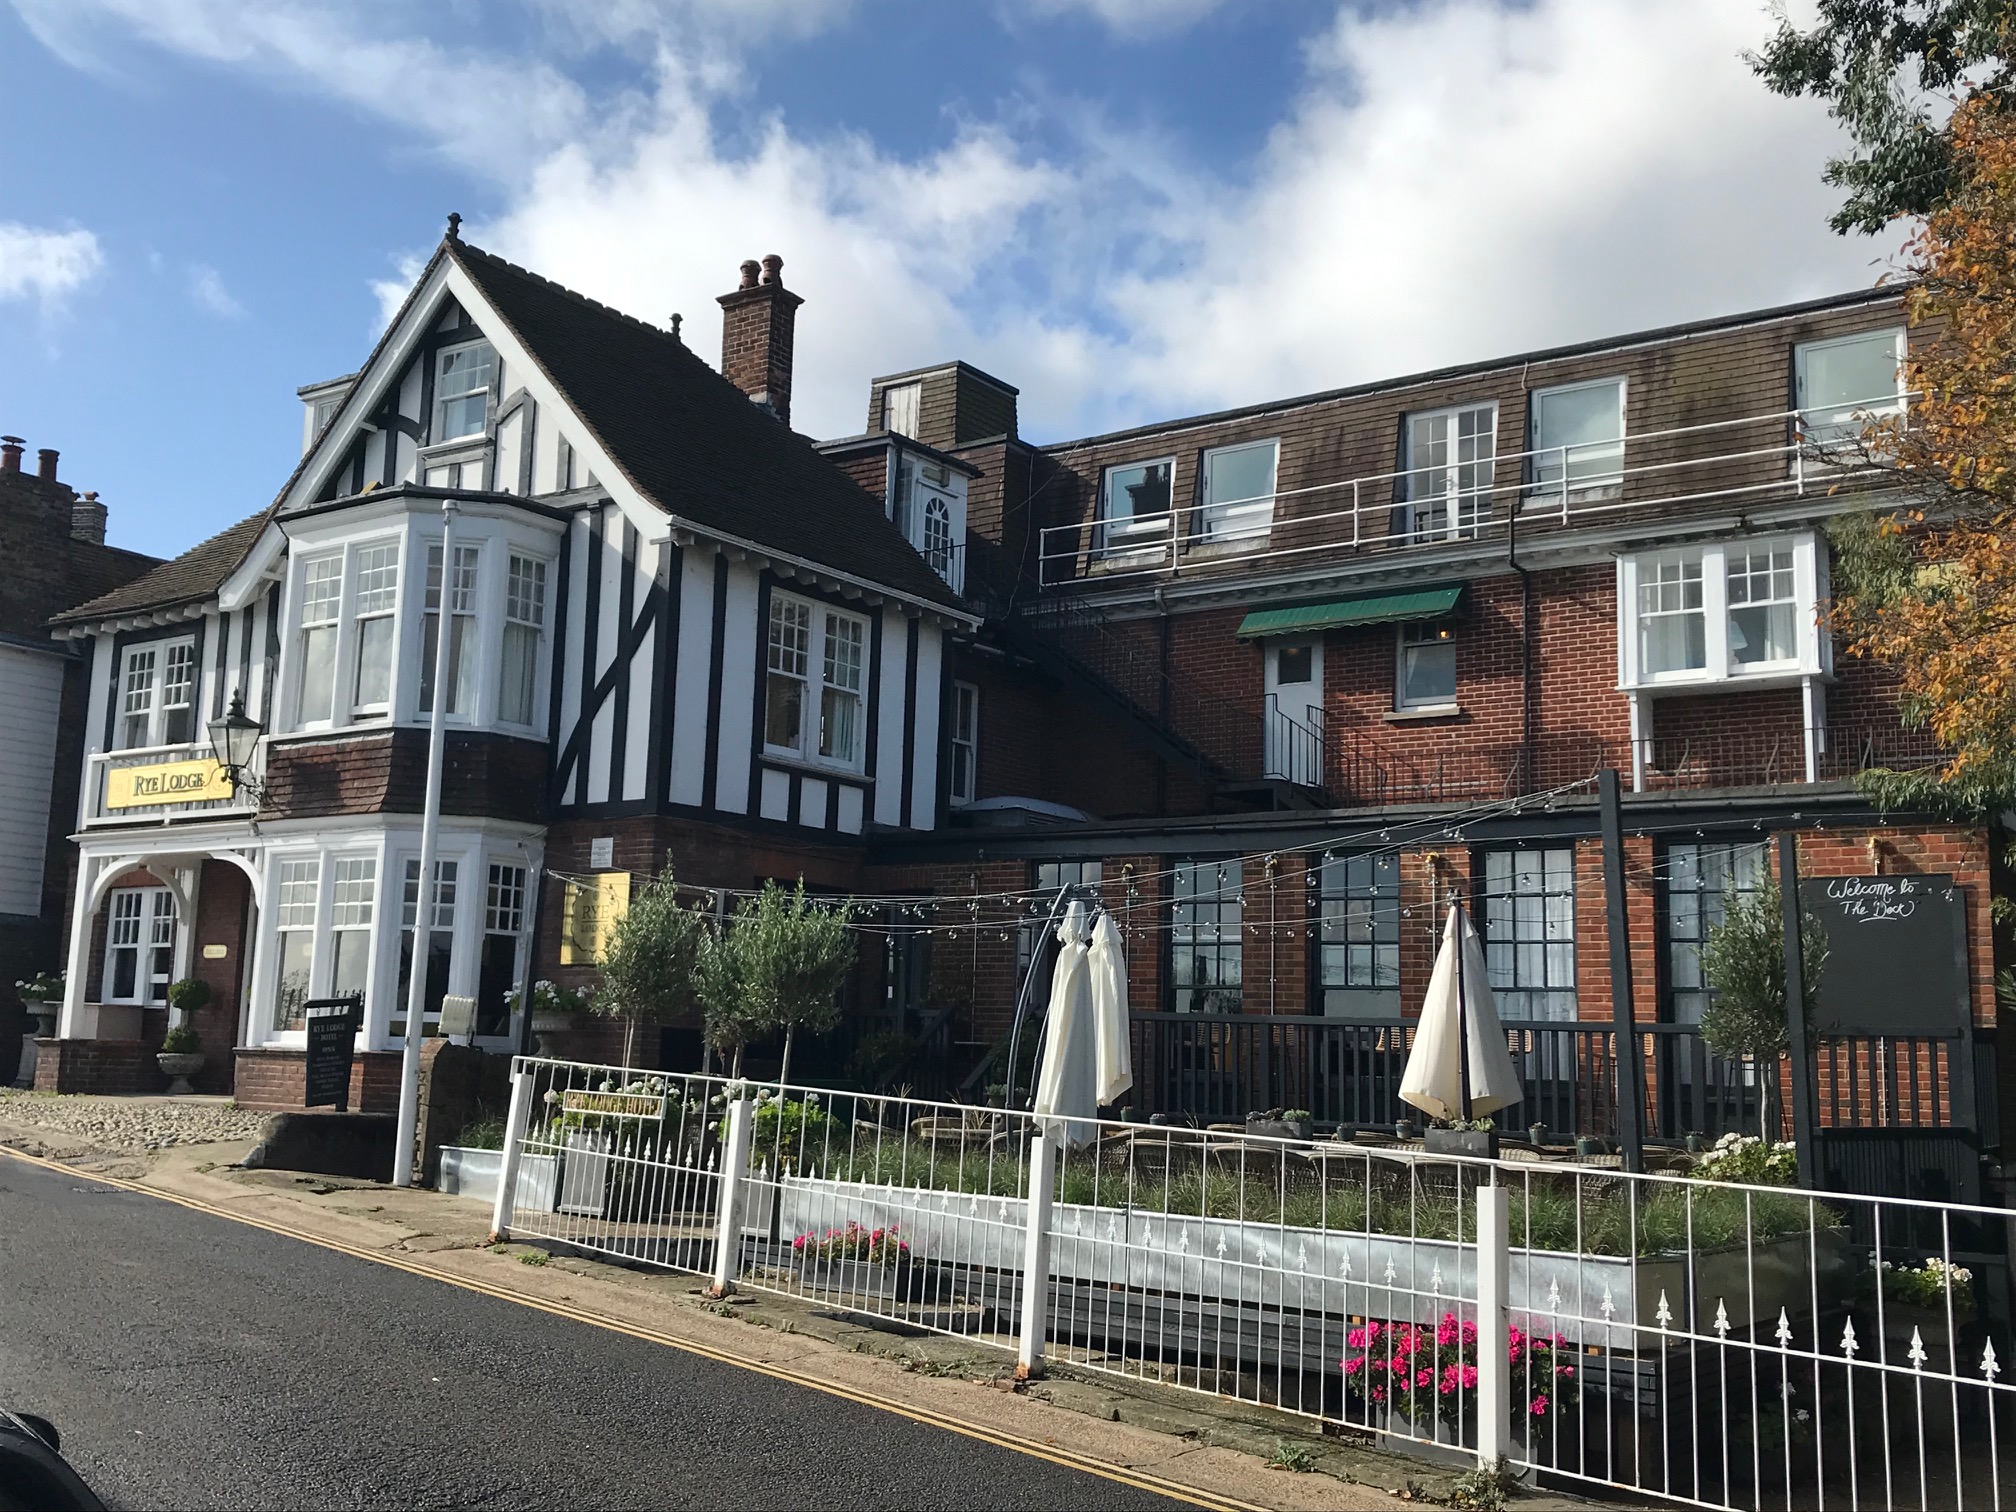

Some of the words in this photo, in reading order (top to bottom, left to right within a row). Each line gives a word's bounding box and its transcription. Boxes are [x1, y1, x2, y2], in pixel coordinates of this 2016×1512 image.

[133, 776, 158, 796] RYE
[1827, 877, 1897, 902] Welcome
[1901, 878, 1920, 893] to
[582, 904, 609, 919] RYE
[1839, 898, 1868, 915] The
